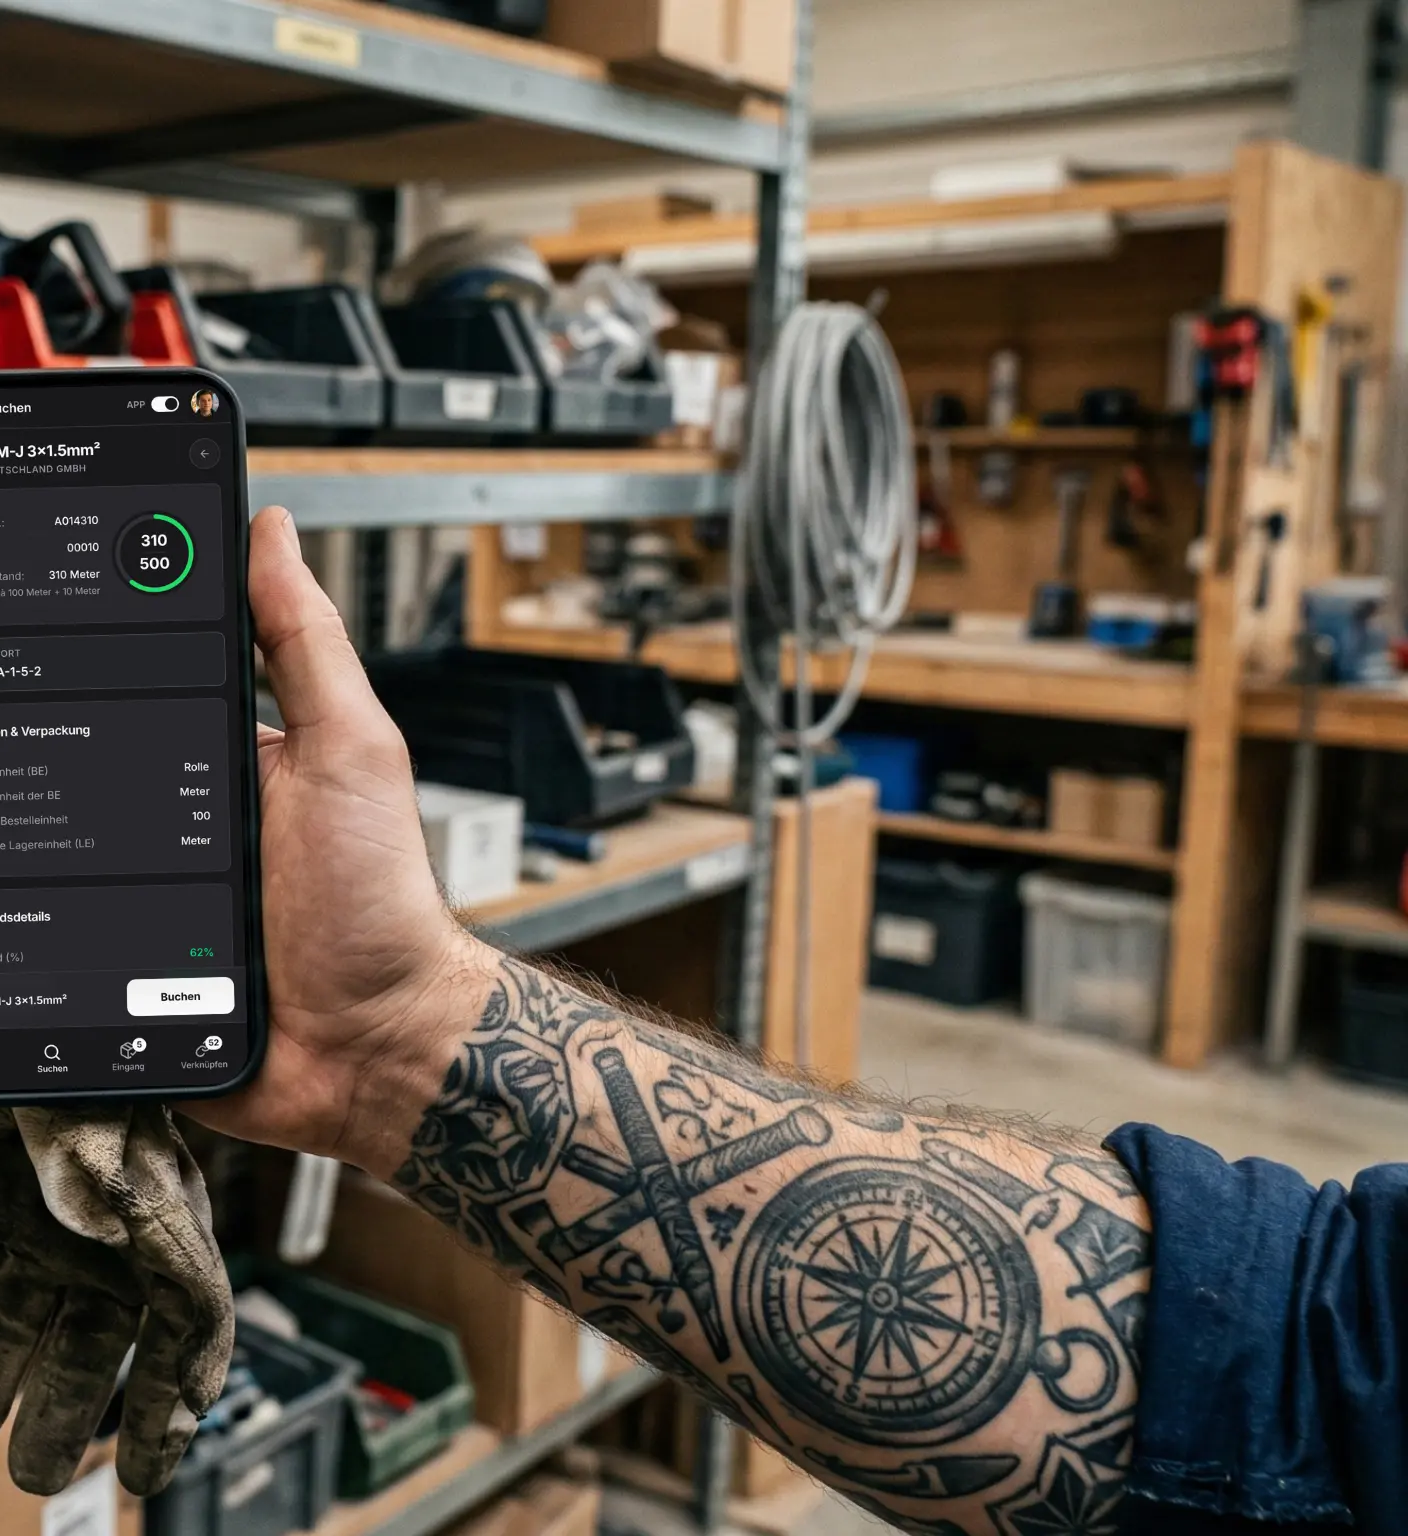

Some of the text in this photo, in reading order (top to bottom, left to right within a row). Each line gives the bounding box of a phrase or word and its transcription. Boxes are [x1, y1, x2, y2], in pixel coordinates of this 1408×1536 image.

[55, 516, 98, 525] A014310
[142, 534, 167, 546] 310
[67, 543, 99, 552] 00010
[140, 557, 169, 570] 500
[49, 570, 66, 579] 310
[70, 570, 100, 578] Meter
[63, 587, 72, 595] 10
[11, 727, 18, 736] &
[21, 726, 90, 738] Verpackung
[28, 766, 48, 776] (BE)
[185, 763, 209, 771] Rolle
[28, 792, 44, 800] der
[48, 791, 60, 799] BE
[180, 788, 210, 796] Meter
[1, 815, 68, 825] Bestelleinheit
[192, 811, 210, 820] 100
[9, 840, 71, 851] Lagereinheit
[75, 838, 94, 849] (LE)
[182, 836, 211, 845] Meter
[6, 952, 23, 962] (%)
[190, 948, 213, 956] 62%
[161, 992, 200, 1001] Buchen
[207, 1037, 220, 1046] 52
[113, 1063, 144, 1072] Eingang
[181, 1061, 228, 1069] Verknüpfen
